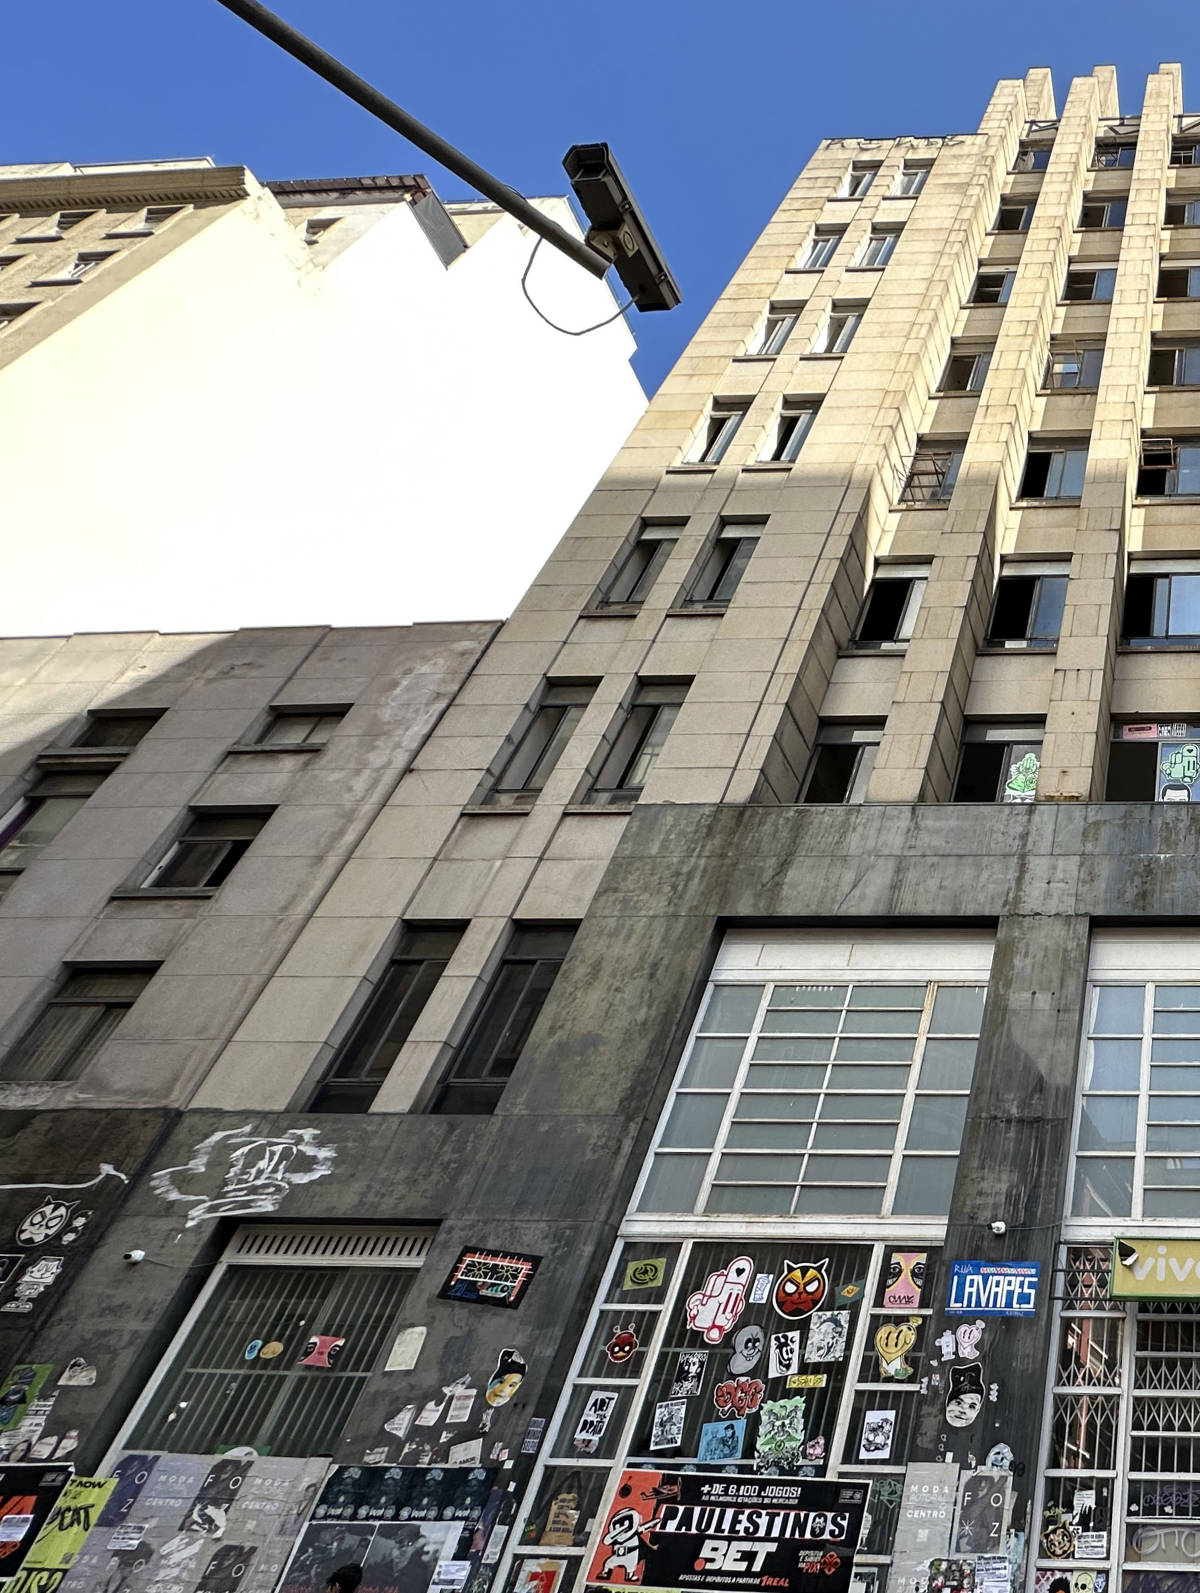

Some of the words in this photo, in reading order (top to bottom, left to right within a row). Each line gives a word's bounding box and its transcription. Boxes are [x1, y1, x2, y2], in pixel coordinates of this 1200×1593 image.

[953, 1263, 974, 1274] RUA
[761, 1485, 802, 1498] JOGOS!
[910, 1485, 949, 1493] MODA
[906, 1509, 946, 1519] CENTRO
[659, 1505, 848, 1540] PAULESTINOS
